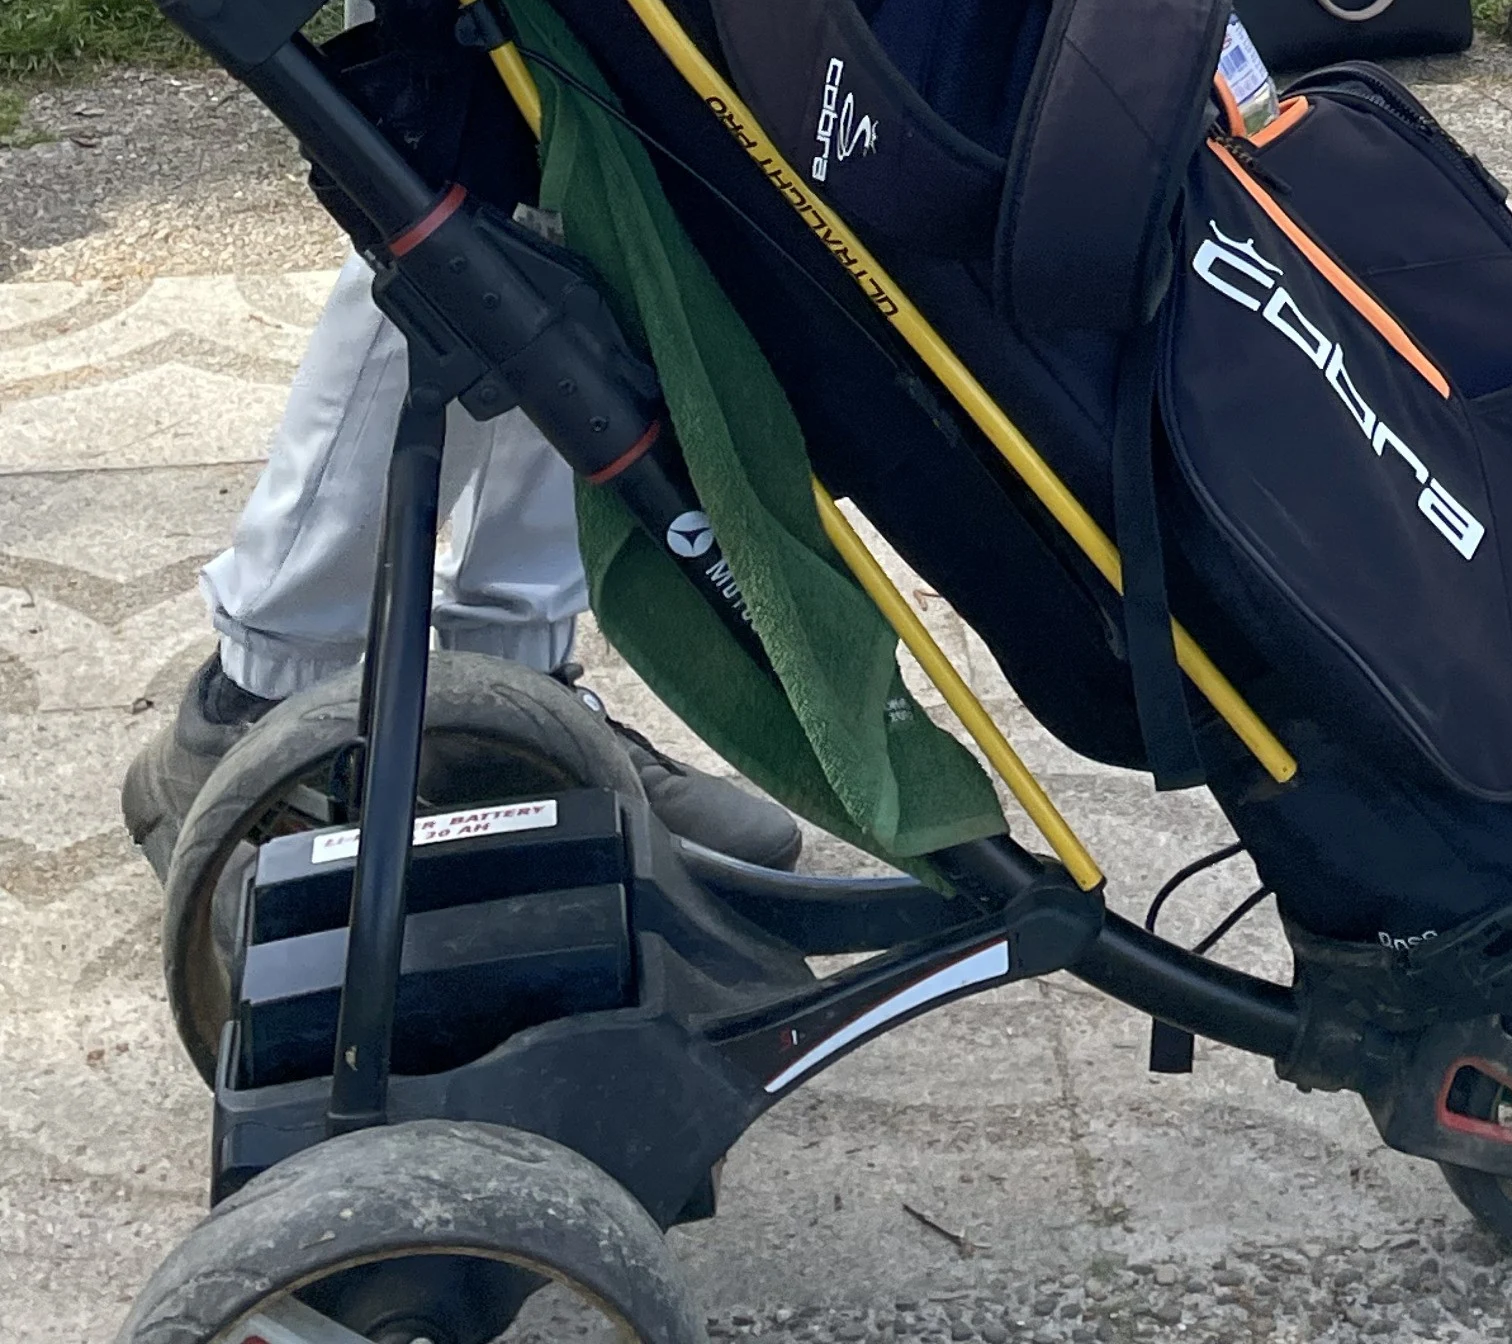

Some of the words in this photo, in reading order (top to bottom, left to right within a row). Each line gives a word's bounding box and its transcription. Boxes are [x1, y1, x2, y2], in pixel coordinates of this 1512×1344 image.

[706, 95, 758, 149] PRO
[811, 57, 844, 182] cobra
[758, 157, 899, 317] ULTRALIGHT
[1192, 236, 1486, 561] cobra
[450, 806, 545, 825] BATTERY
[459, 822, 491, 834] AH
